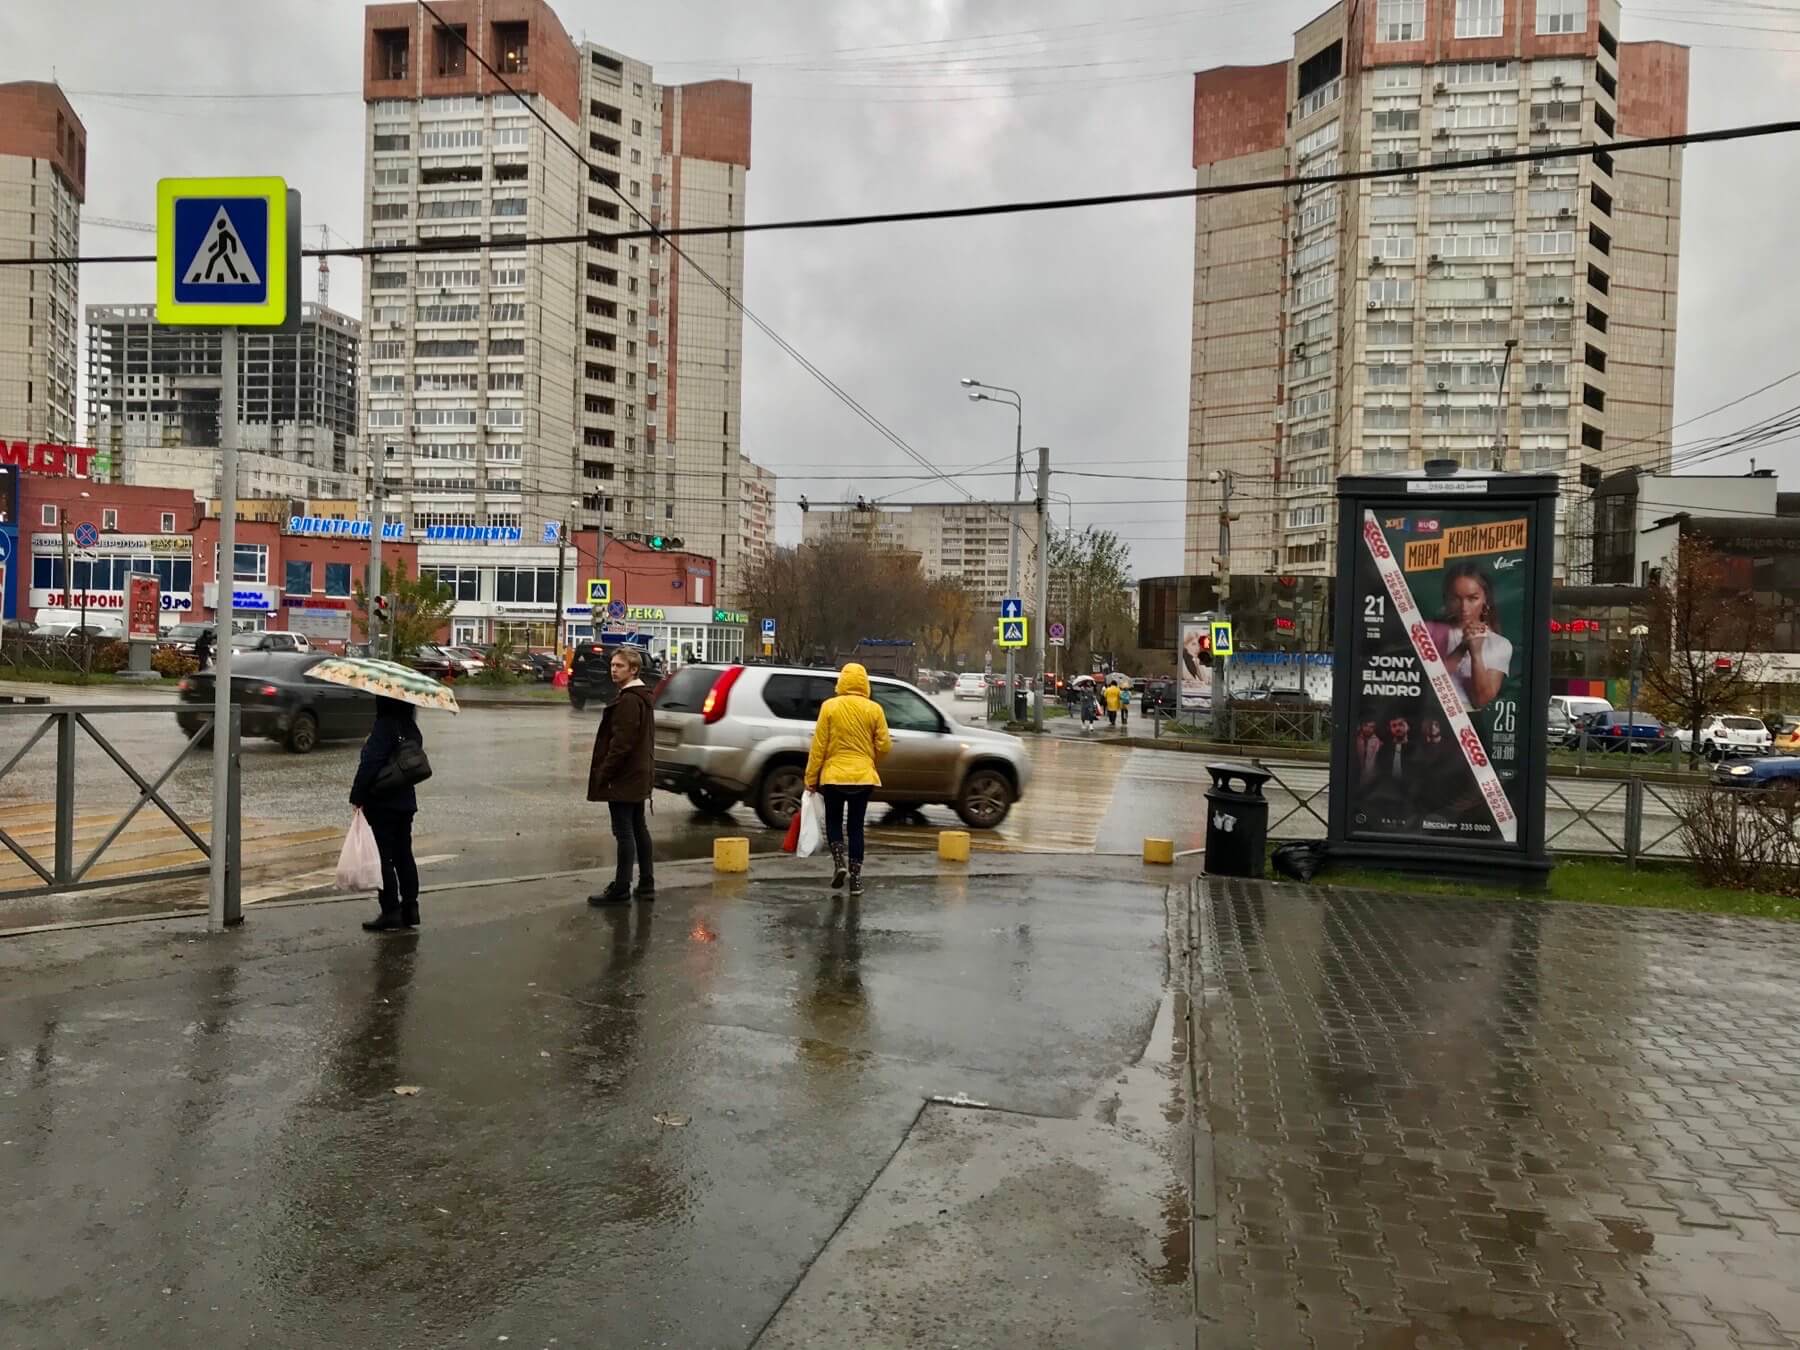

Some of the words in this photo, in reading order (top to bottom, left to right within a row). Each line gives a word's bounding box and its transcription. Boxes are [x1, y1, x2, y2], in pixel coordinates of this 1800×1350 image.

[291, 516, 404, 537] ЭЛЕКТРОНЫЕ
[427, 525, 521, 541] КОМПОНЕНТЫ
[1409, 543, 1440, 568] МАРИ
[1448, 523, 1525, 554] КРАЙМБРЕРИ
[1364, 595, 1385, 616] 21
[1369, 655, 1415, 668] JONY
[1362, 670, 1420, 682] ELMAN
[1362, 684, 1421, 697] ANDRO
[1494, 701, 1516, 732] 26
